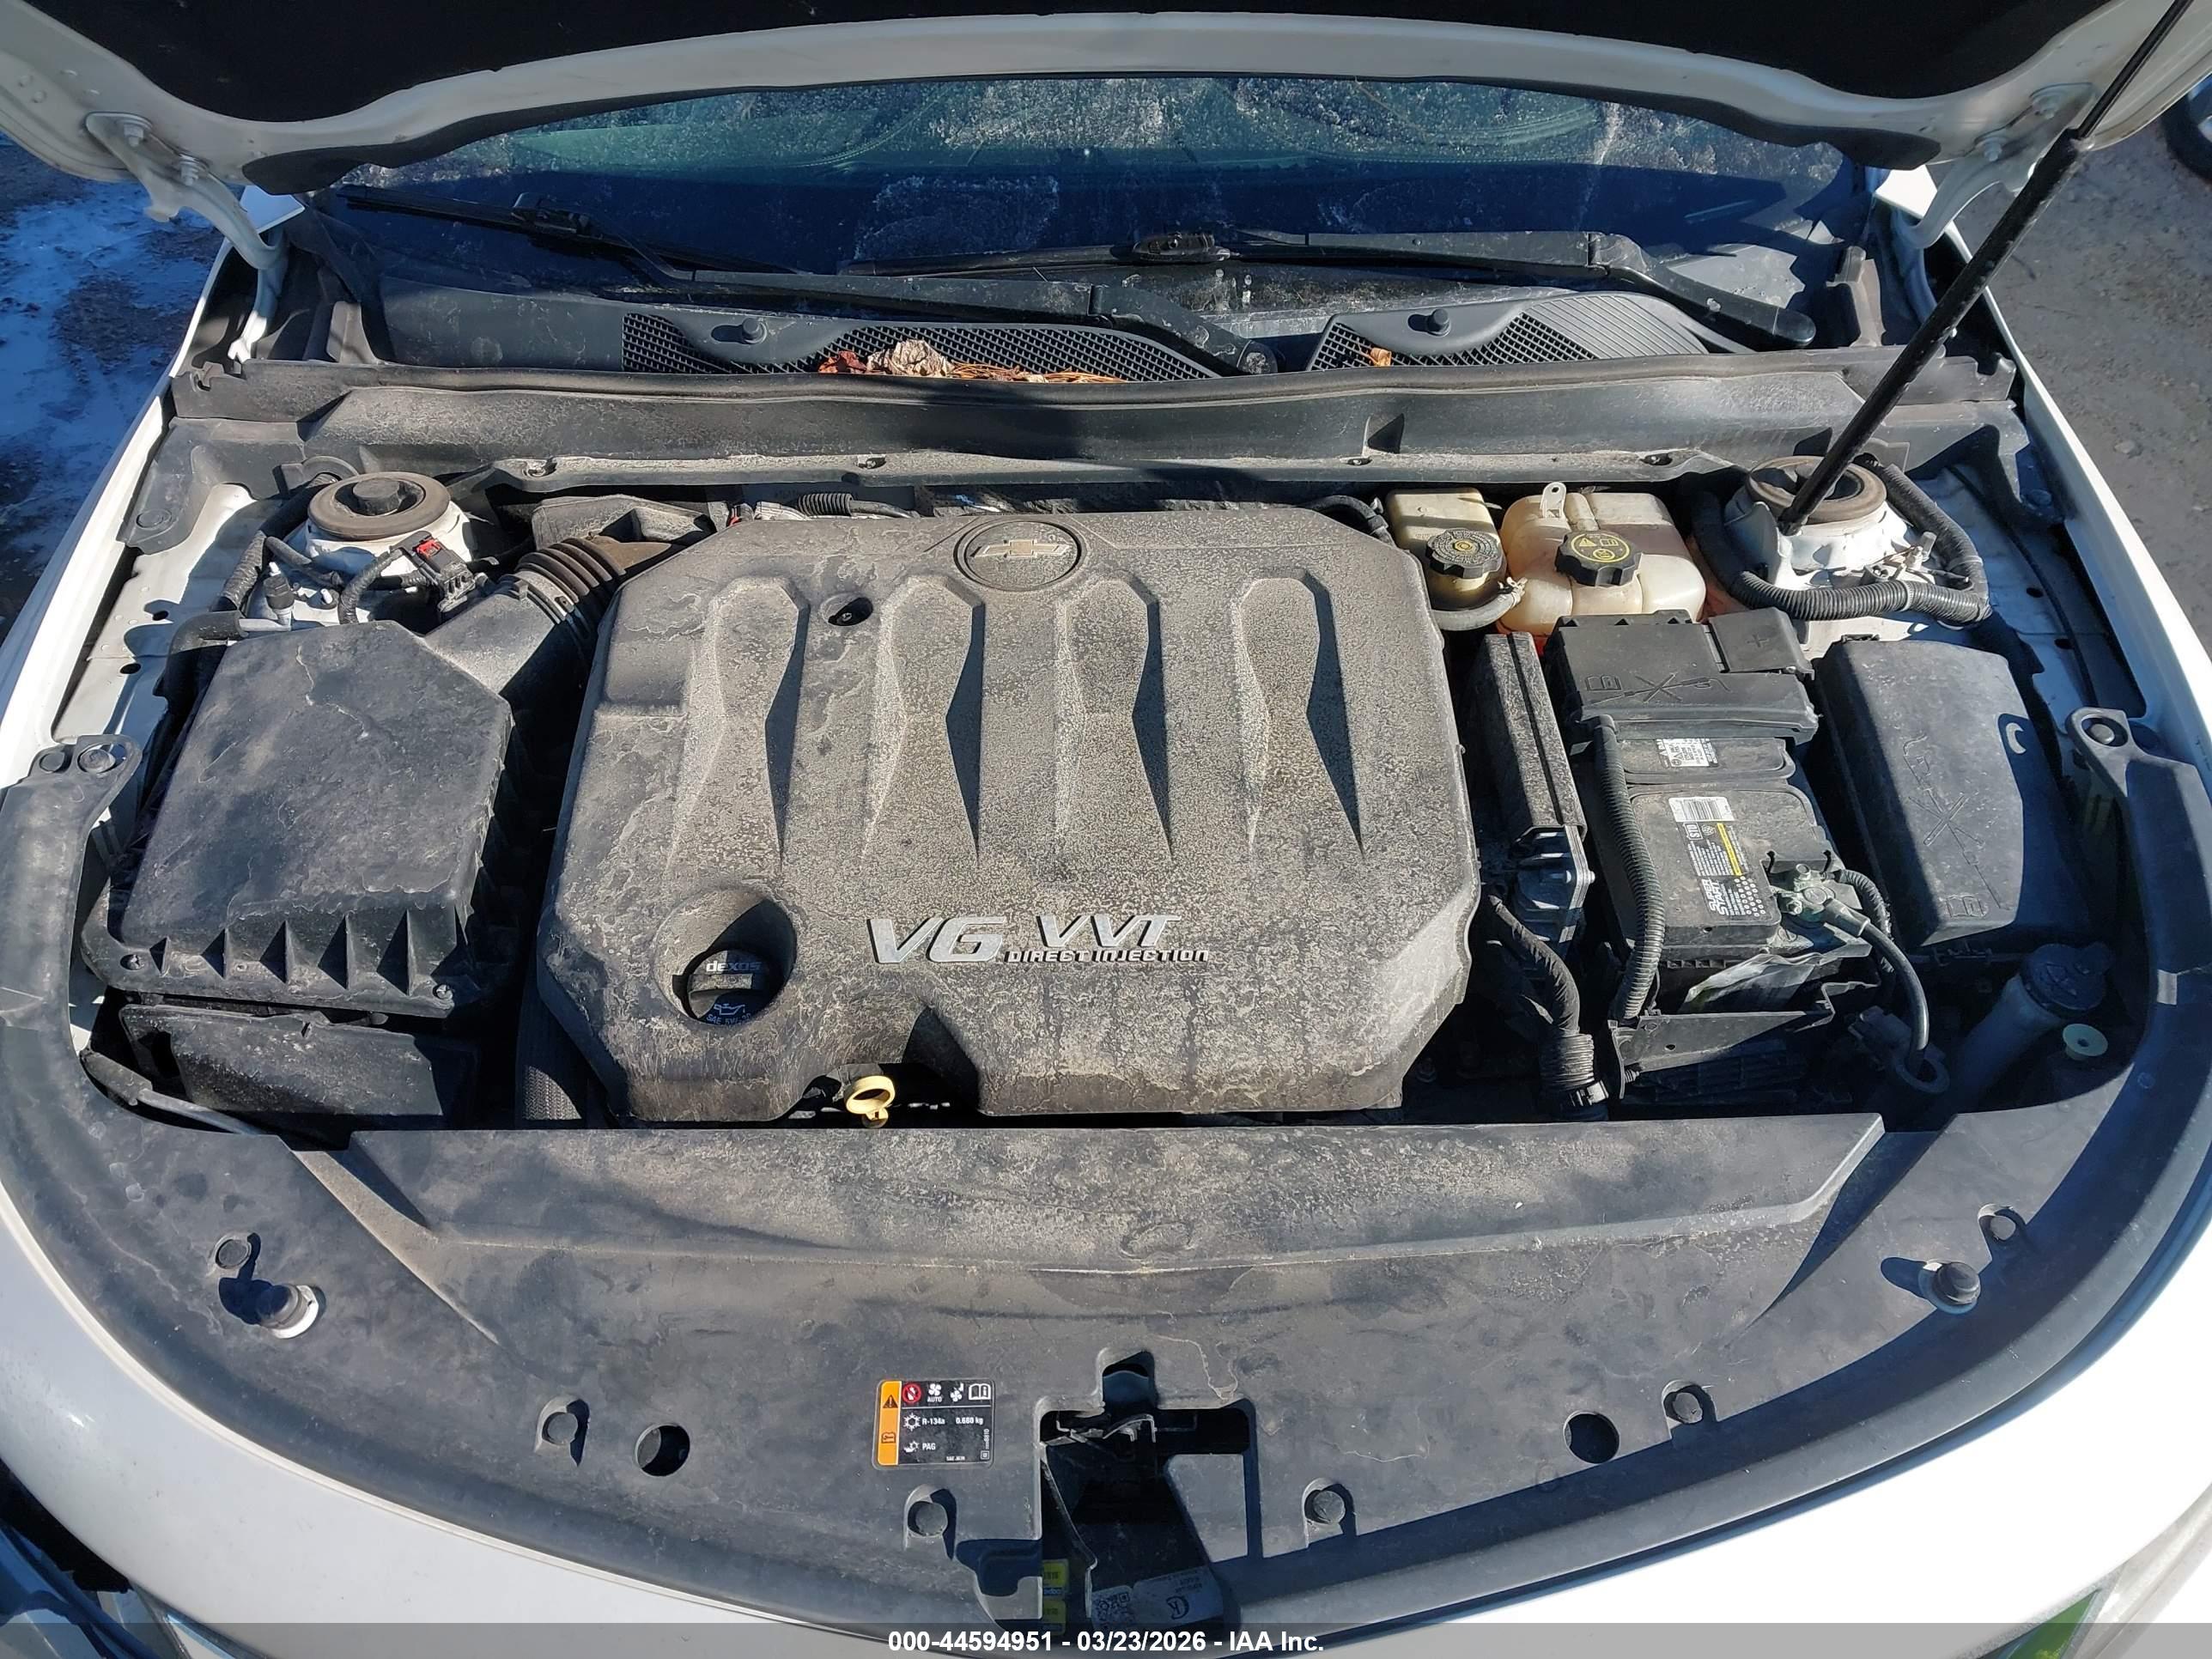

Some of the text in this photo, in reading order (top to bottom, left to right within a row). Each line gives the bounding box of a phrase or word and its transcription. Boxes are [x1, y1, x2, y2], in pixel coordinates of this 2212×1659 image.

[1701, 878, 1717, 911] SUPER
[1711, 880, 1729, 916] START
[866, 915, 1182, 963] V6 VVT
[1005, 949, 1209, 963] DIRECT INJECTION
[706, 960, 763, 972] dexos
[706, 1013, 722, 1024] SAE
[975, 1416, 983, 1425] kg
